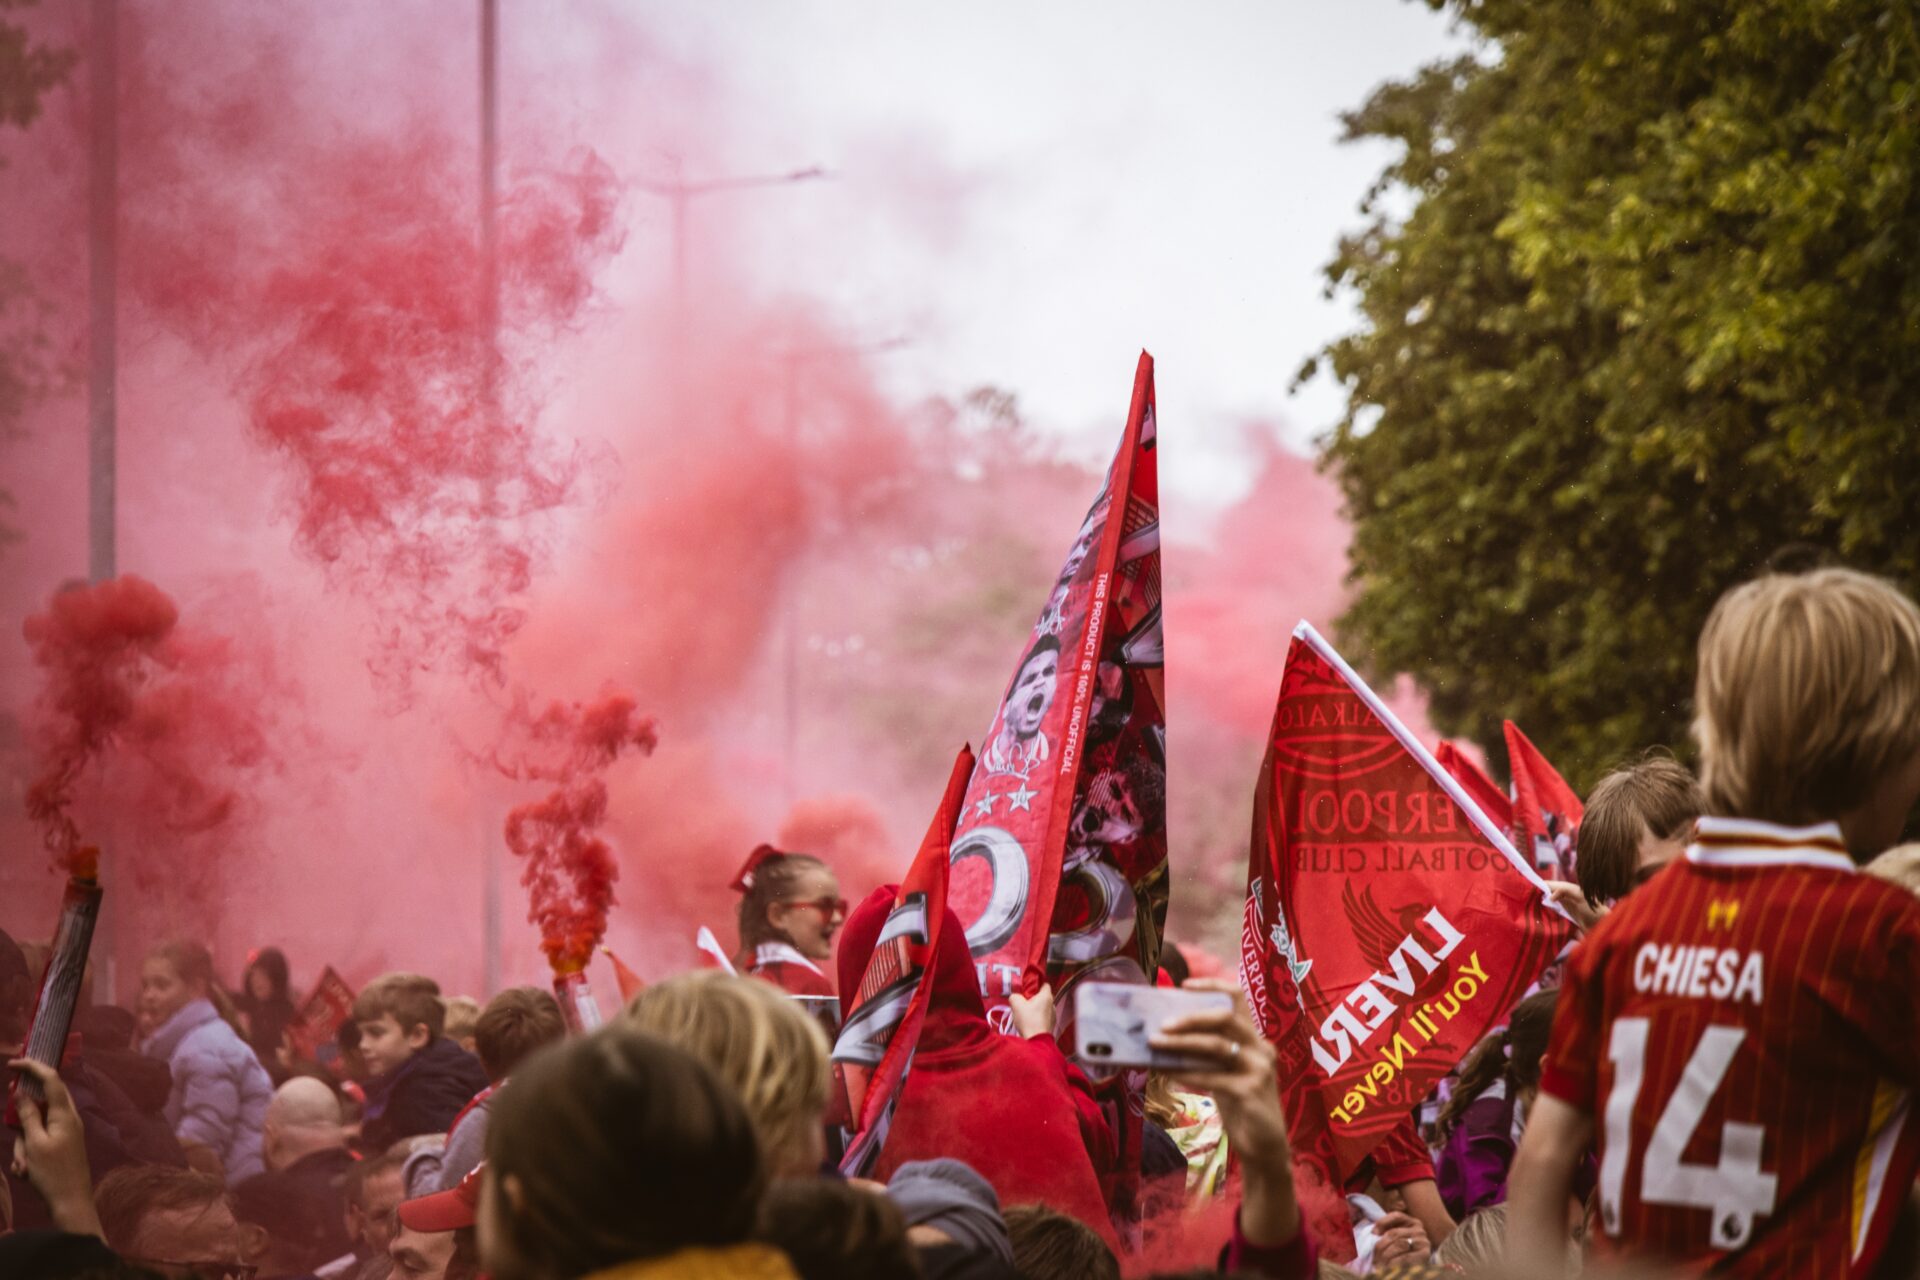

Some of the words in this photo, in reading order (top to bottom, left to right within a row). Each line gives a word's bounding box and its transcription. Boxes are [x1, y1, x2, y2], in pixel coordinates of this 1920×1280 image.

[1095, 572, 1109, 599] THIS
[1083, 601, 1103, 658] PRODUCT
[1074, 674, 1089, 703] 100%
[1081, 660, 1092, 672] IS
[1060, 705, 1084, 776] UNOFFICIAL
[1633, 942, 1764, 1005] CHIESA
[1601, 1017, 1778, 1250] 14
